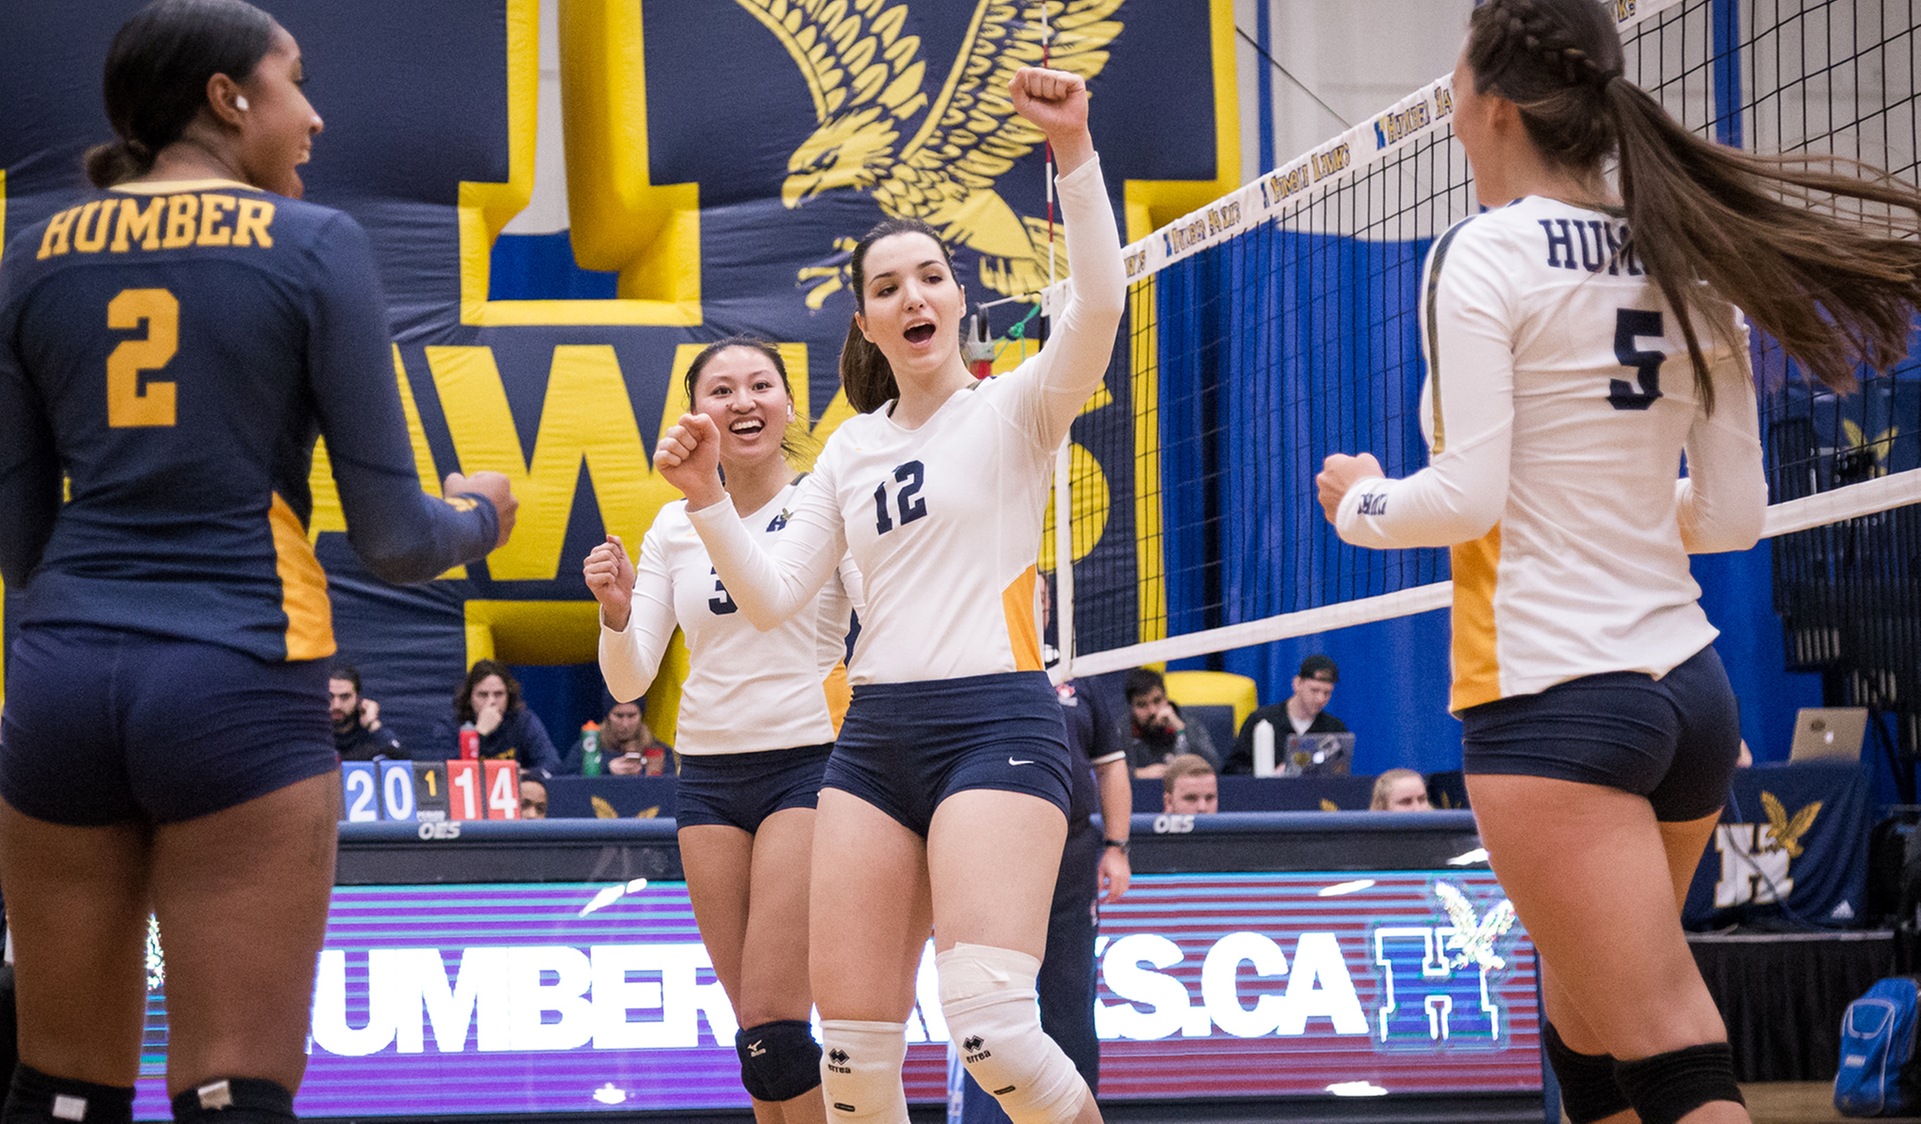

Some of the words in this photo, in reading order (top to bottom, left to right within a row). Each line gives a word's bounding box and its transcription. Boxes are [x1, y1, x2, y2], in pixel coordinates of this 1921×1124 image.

[37, 193, 276, 261] HUMBER
[1537, 218, 1647, 276] HUM
[106, 288, 180, 428] 2
[1606, 308, 1667, 410] 5
[874, 460, 928, 535] 12
[346, 766, 414, 823] 20
[424, 770, 437, 797] 1
[454, 767, 518, 820] 14
[1153, 814, 1195, 834] OES
[418, 821, 461, 840] OES
